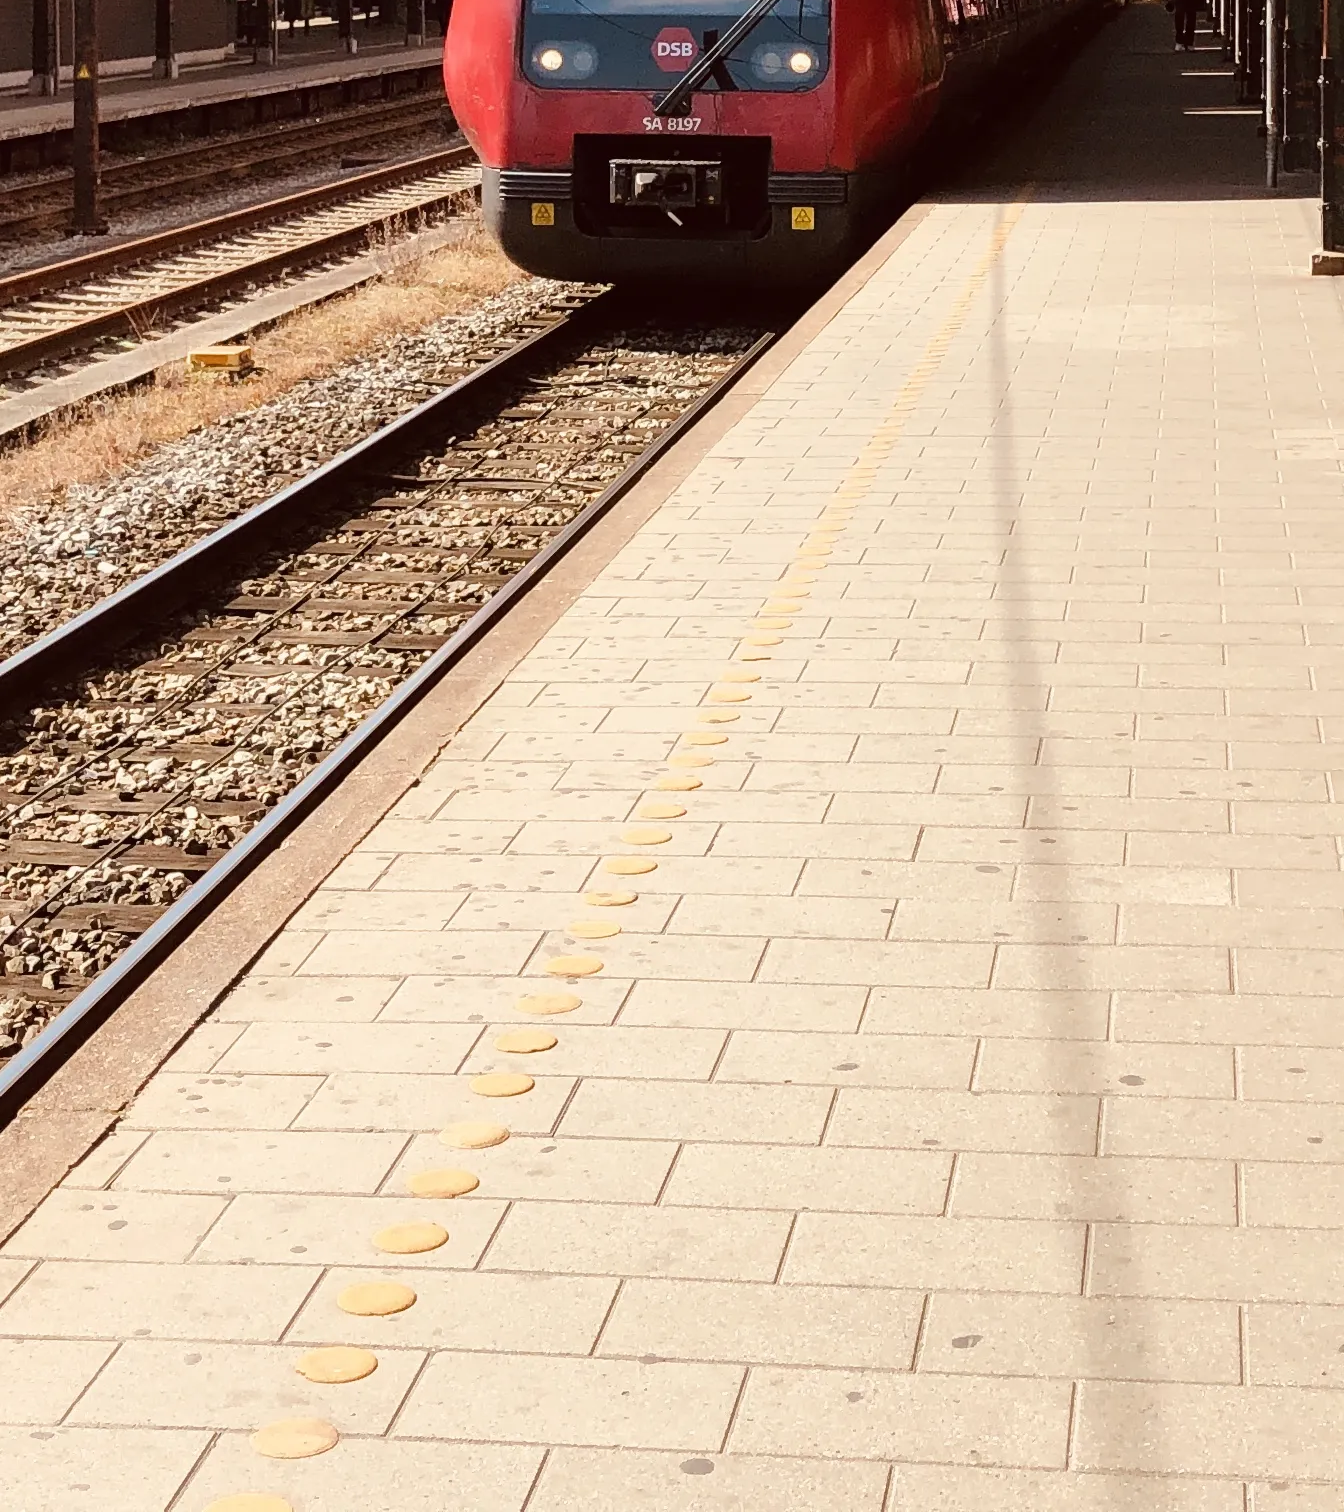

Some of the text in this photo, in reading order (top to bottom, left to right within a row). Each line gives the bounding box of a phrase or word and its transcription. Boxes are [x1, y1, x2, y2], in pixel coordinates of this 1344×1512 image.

[657, 42, 693, 57] DSB
[642, 117, 702, 131] SA 8197
